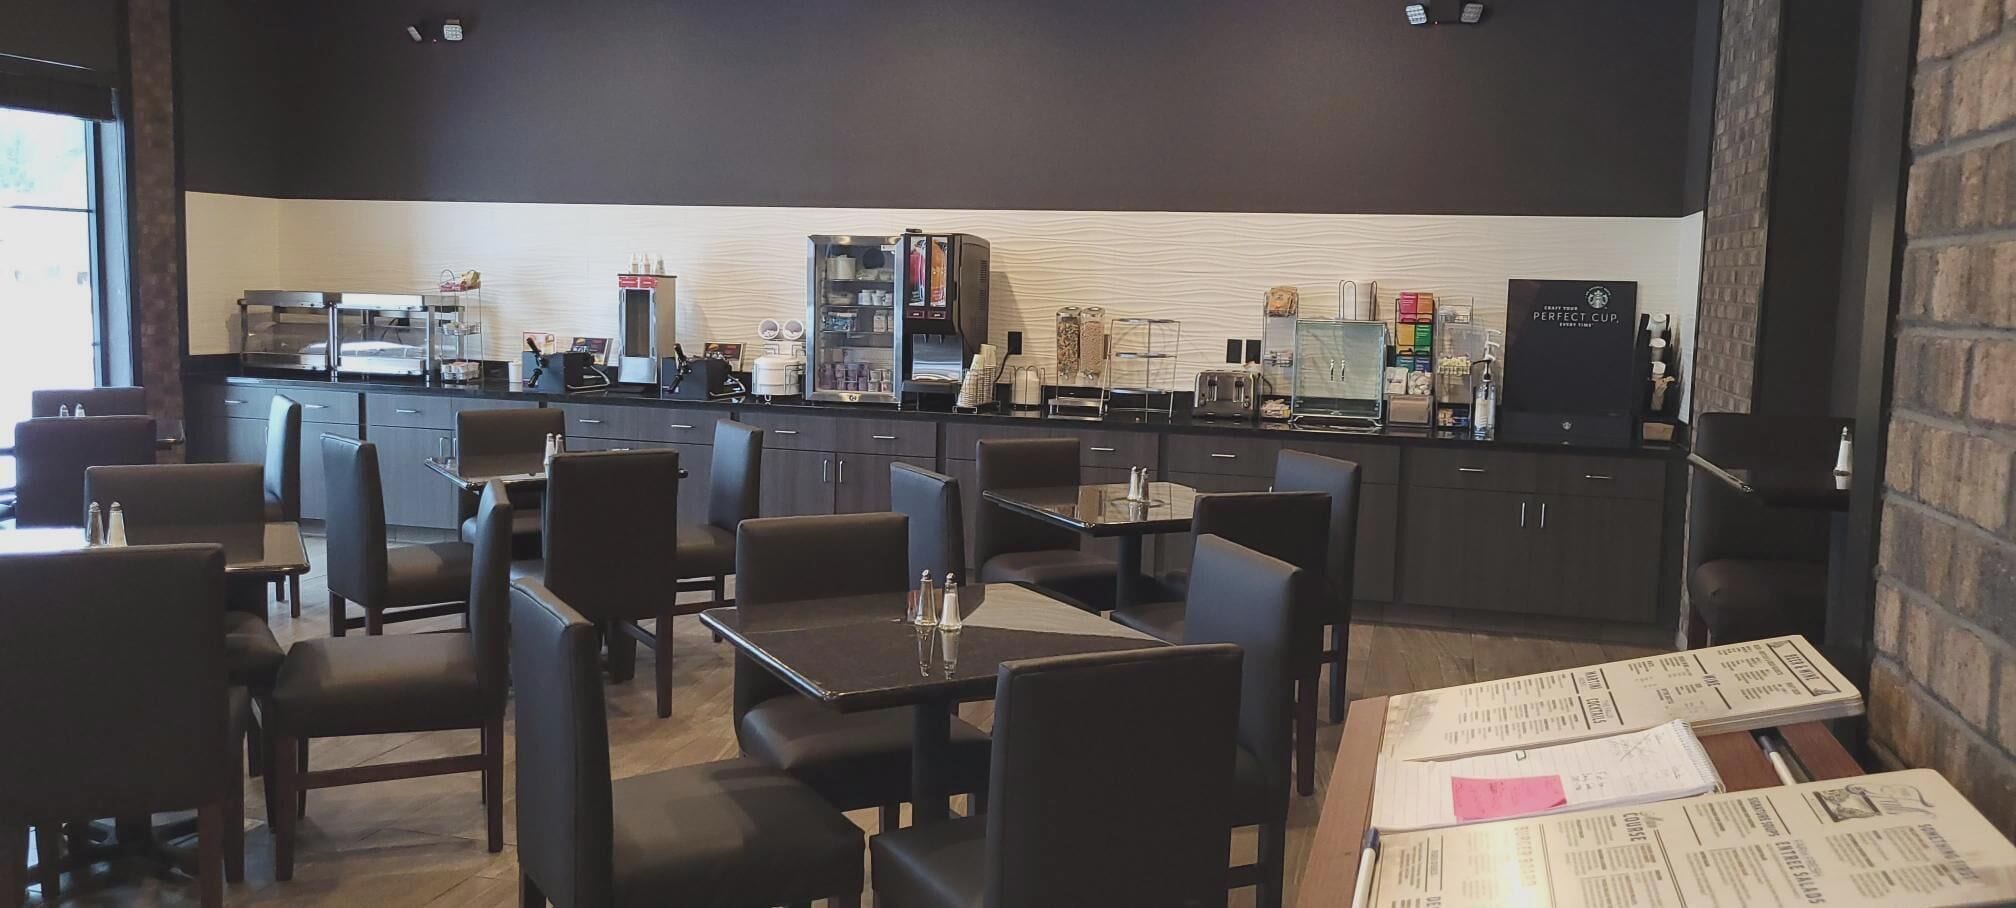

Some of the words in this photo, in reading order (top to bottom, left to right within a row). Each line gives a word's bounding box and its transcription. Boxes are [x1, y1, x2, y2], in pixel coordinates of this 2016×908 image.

[1533, 311, 1586, 322] PERFECT
[1585, 670, 1603, 690] MARTINI
[1702, 674, 1721, 687] WINE
[1783, 653, 1804, 667] BEER
[1798, 668, 1820, 681] WINE
[1586, 698, 1607, 724] COCKTAILS
[1623, 812, 1647, 842] COURSE
[1747, 797, 1772, 822] SIGNATURE
[1760, 820, 1780, 837] SOUPS
[1918, 824, 1961, 860] SOMETHING
[1949, 860, 1979, 880] FIRST
[1775, 841, 1806, 871] ENTREE
[1793, 871, 1826, 904] SALADS
